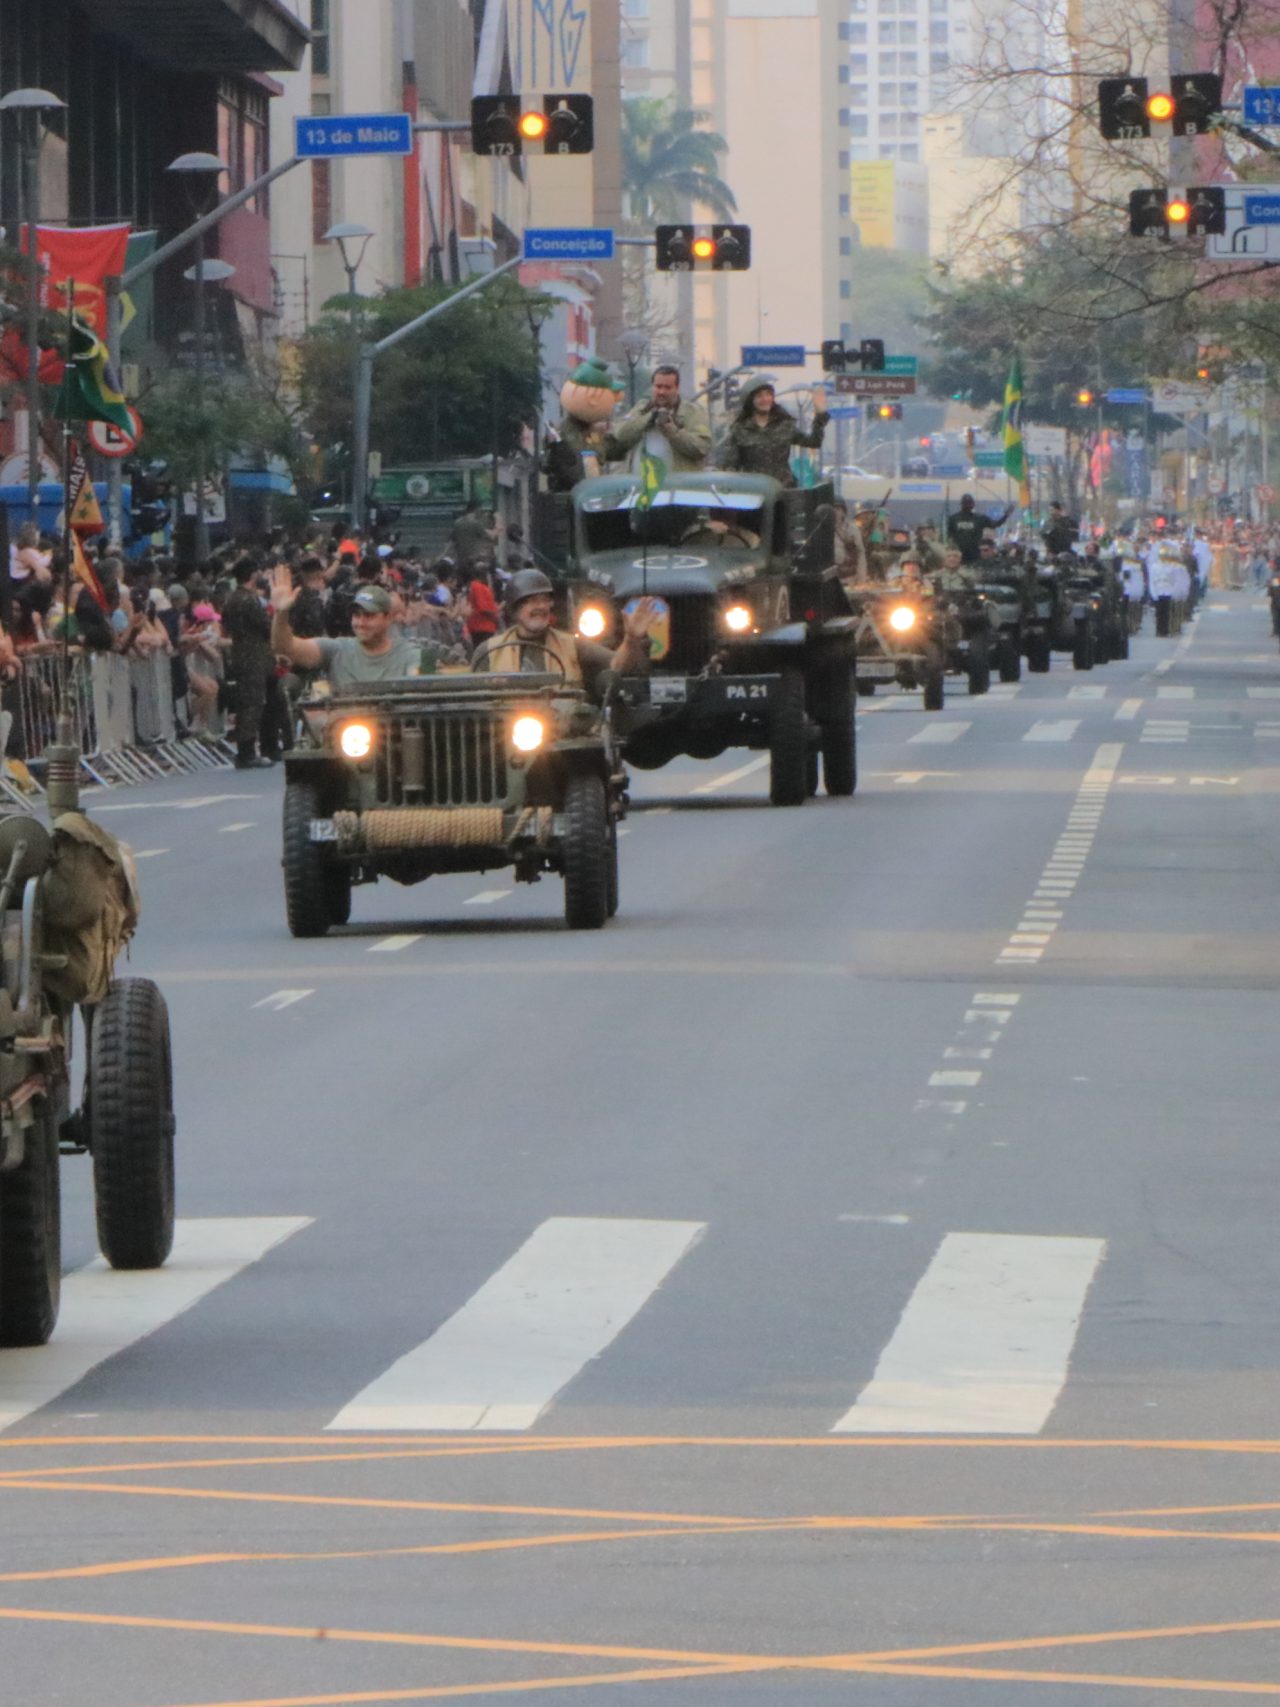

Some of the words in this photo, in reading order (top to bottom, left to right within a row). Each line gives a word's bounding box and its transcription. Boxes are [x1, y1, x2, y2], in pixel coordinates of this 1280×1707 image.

[306, 128, 327, 145] 13
[331, 127, 354, 144] de
[357, 126, 402, 143] Maio
[1117, 126, 1144, 139] 173
[1185, 122, 1198, 135] B
[489, 142, 515, 155] 173
[530, 238, 606, 253] Conceição
[726, 685, 747, 699] PA
[749, 684, 768, 698] 21
